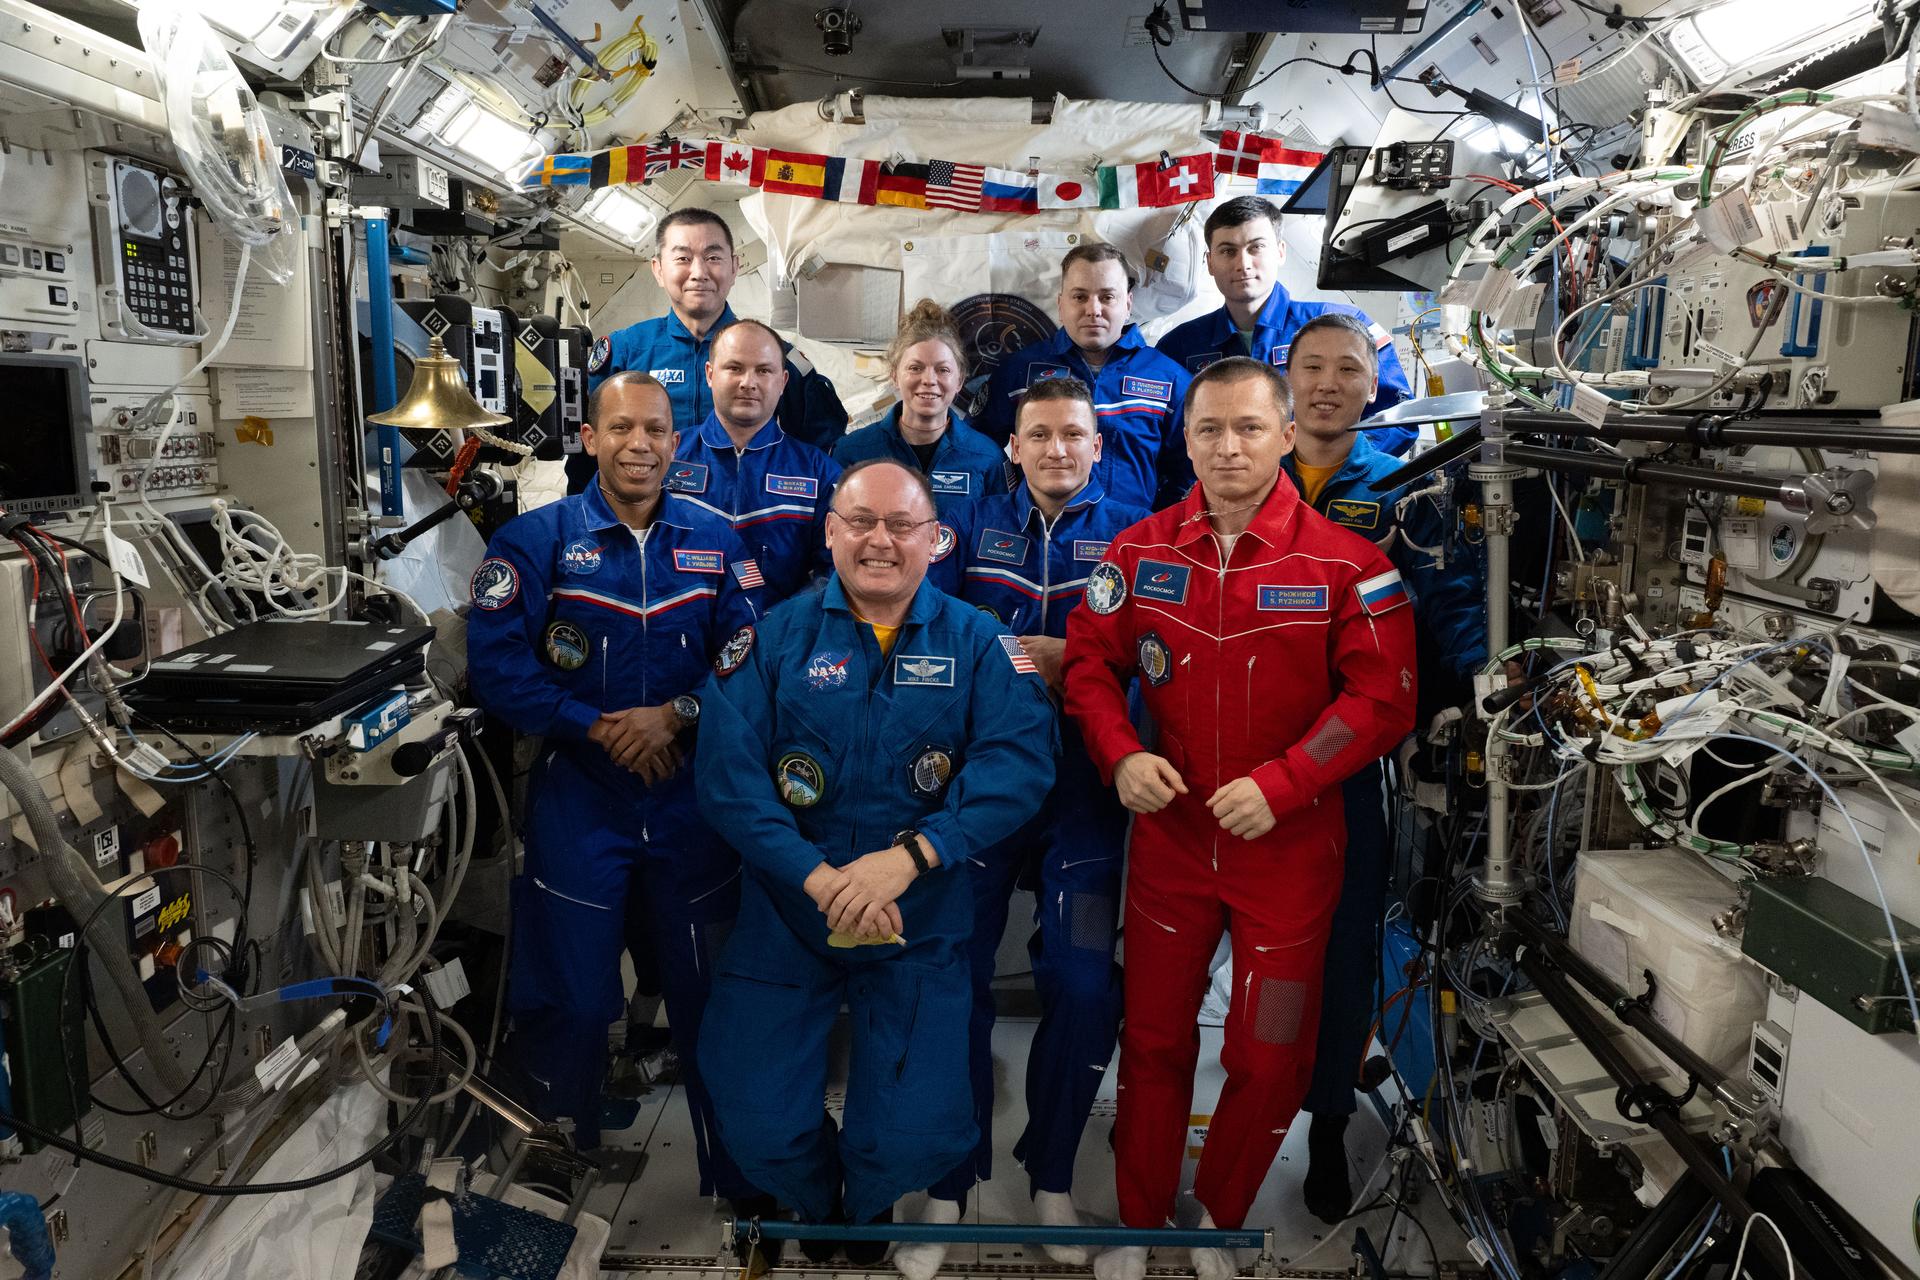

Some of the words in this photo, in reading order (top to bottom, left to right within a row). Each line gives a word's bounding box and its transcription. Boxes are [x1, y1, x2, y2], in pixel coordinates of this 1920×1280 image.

[1727, 132, 1756, 152] PRESS
[656, 369, 684, 384] JAXA
[565, 551, 601, 562] NASA
[1143, 584, 1175, 595] РОСКОСМОС
[808, 665, 847, 678] NASA
